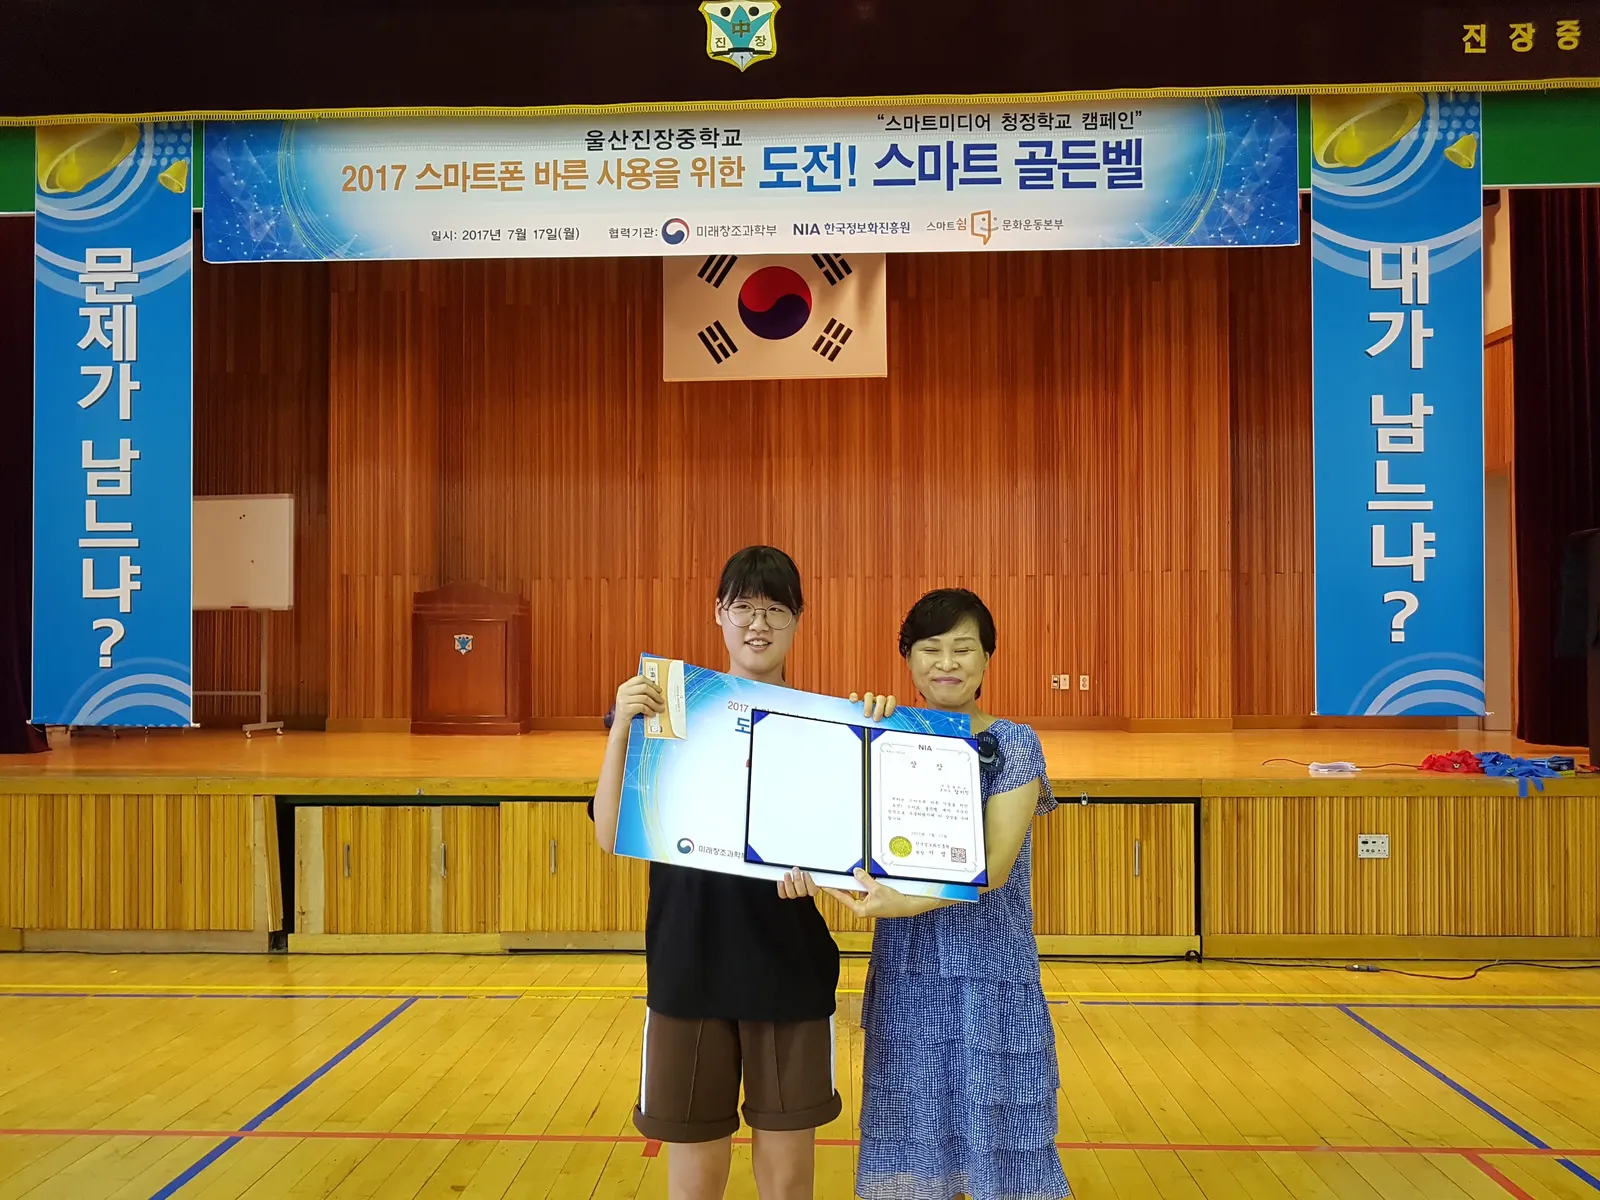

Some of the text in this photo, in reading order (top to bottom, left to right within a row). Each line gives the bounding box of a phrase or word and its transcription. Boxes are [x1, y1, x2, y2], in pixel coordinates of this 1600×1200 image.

[731, 20, 751, 37] 中
[715, 37, 726, 48] 진
[755, 35, 766, 47] 장
[877, 110, 1142, 132] “스마트미디어 청정학교 캠페인”
[584, 127, 743, 151] 울산진장중학교
[759, 138, 1143, 192] 도전! 스마트 골든벨
[341, 155, 746, 192] 2017 스마트폰 바른 사용을 위한
[608, 224, 777, 239] 협력기관: 미래창조과학부
[793, 221, 910, 236] NIA 한국정보화진흥원
[1002, 219, 1064, 231] 문화운동본부
[431, 227, 580, 241] 일시: 2017년 7월 17일(월)
[1365, 245, 1436, 643] 내가 남느냐?
[77, 248, 141, 668] 문제가 남느냐?
[727, 701, 749, 713] 2017
[698, 845, 744, 859] 미래창조과학
